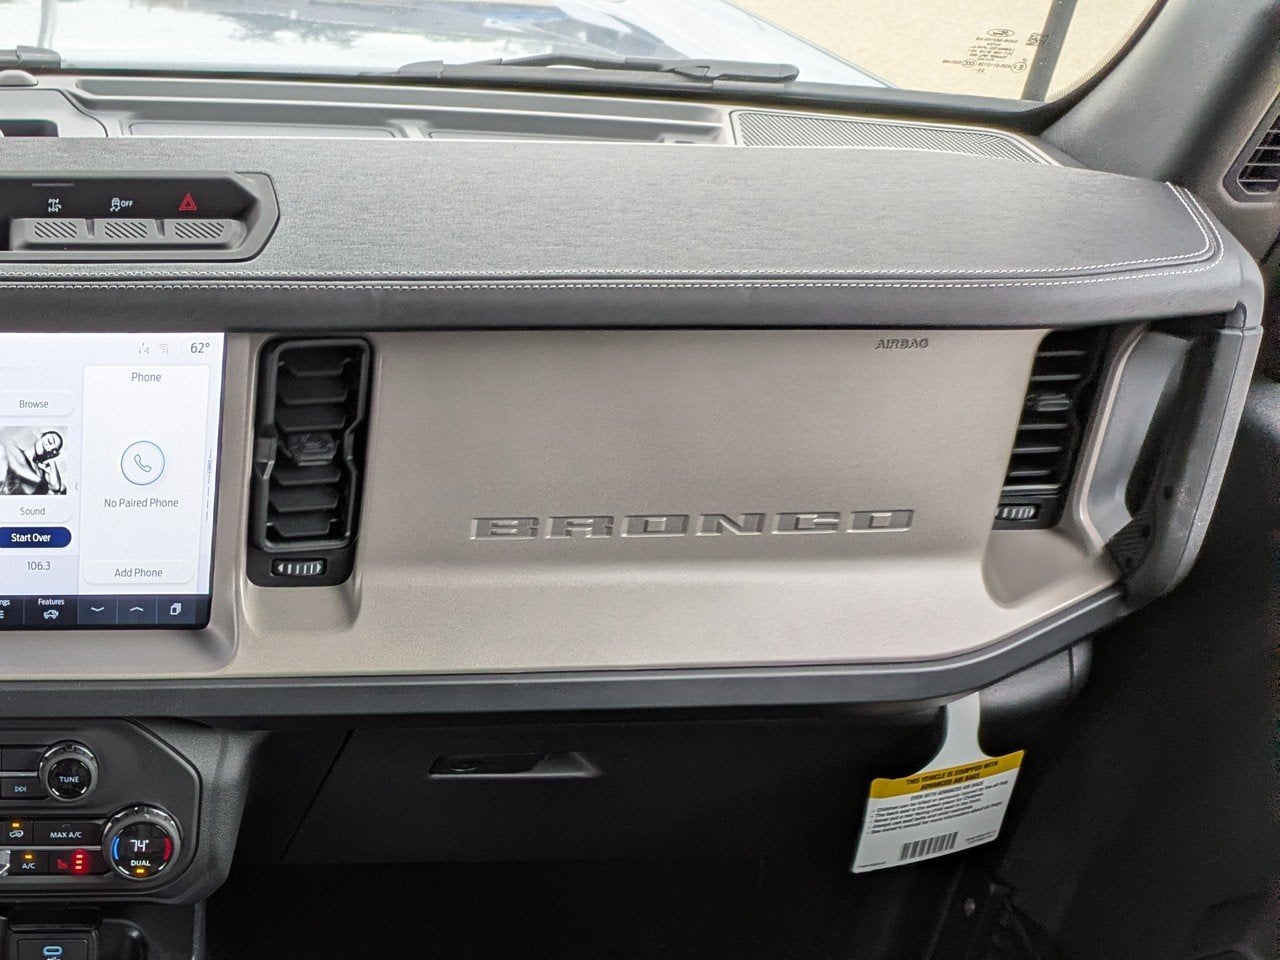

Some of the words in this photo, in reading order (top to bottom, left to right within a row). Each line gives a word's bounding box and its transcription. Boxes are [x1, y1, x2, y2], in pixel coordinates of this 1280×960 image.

[190, 342, 210, 354] 62°
[875, 337, 929, 349] AIRBAG
[131, 372, 162, 382] Phone
[19, 399, 49, 409] Browse
[104, 498, 117, 508] No
[119, 498, 149, 508] Paired
[150, 498, 179, 508] Phone
[20, 507, 46, 516] Sound
[470, 509, 914, 540] BRONCO
[11, 533, 32, 542] Start
[34, 533, 52, 542] Over
[27, 561, 51, 571] 106.3
[114, 568, 130, 578] Add
[133, 568, 163, 578] Phone
[38, 598, 65, 606] Features
[905, 777, 921, 785] THIS
[67, 831, 82, 839] A/C
[130, 839, 150, 852] 74°
